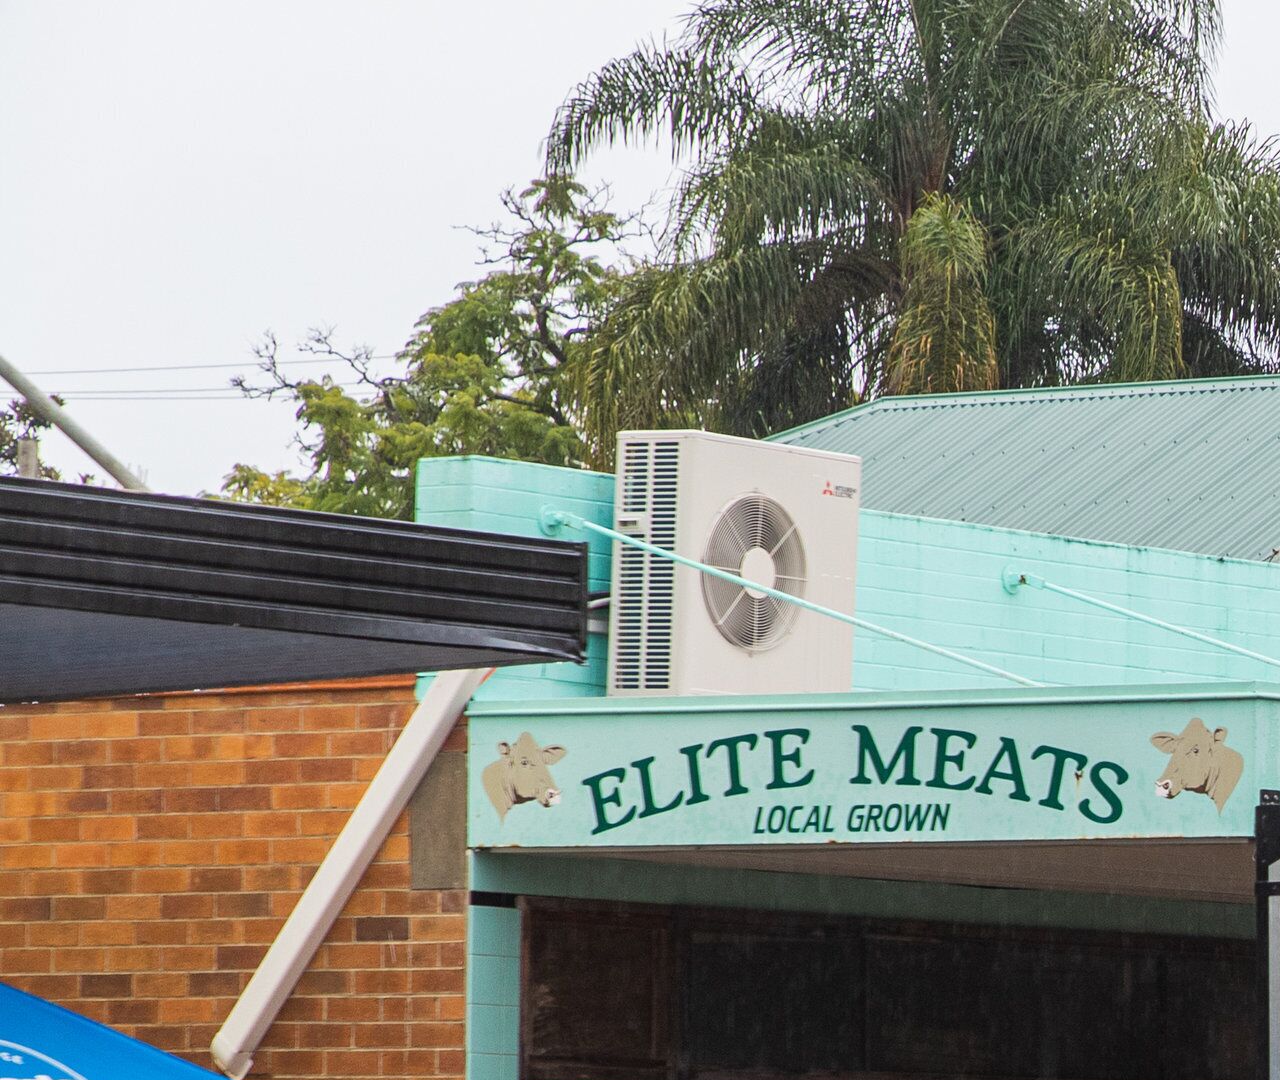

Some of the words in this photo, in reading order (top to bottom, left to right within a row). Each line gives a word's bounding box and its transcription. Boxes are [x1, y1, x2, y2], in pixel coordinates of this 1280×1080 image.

[582, 728, 816, 836] ELITE
[850, 724, 1130, 825] MEATS
[753, 804, 834, 834] LOCAL
[847, 803, 951, 832] GROWN
